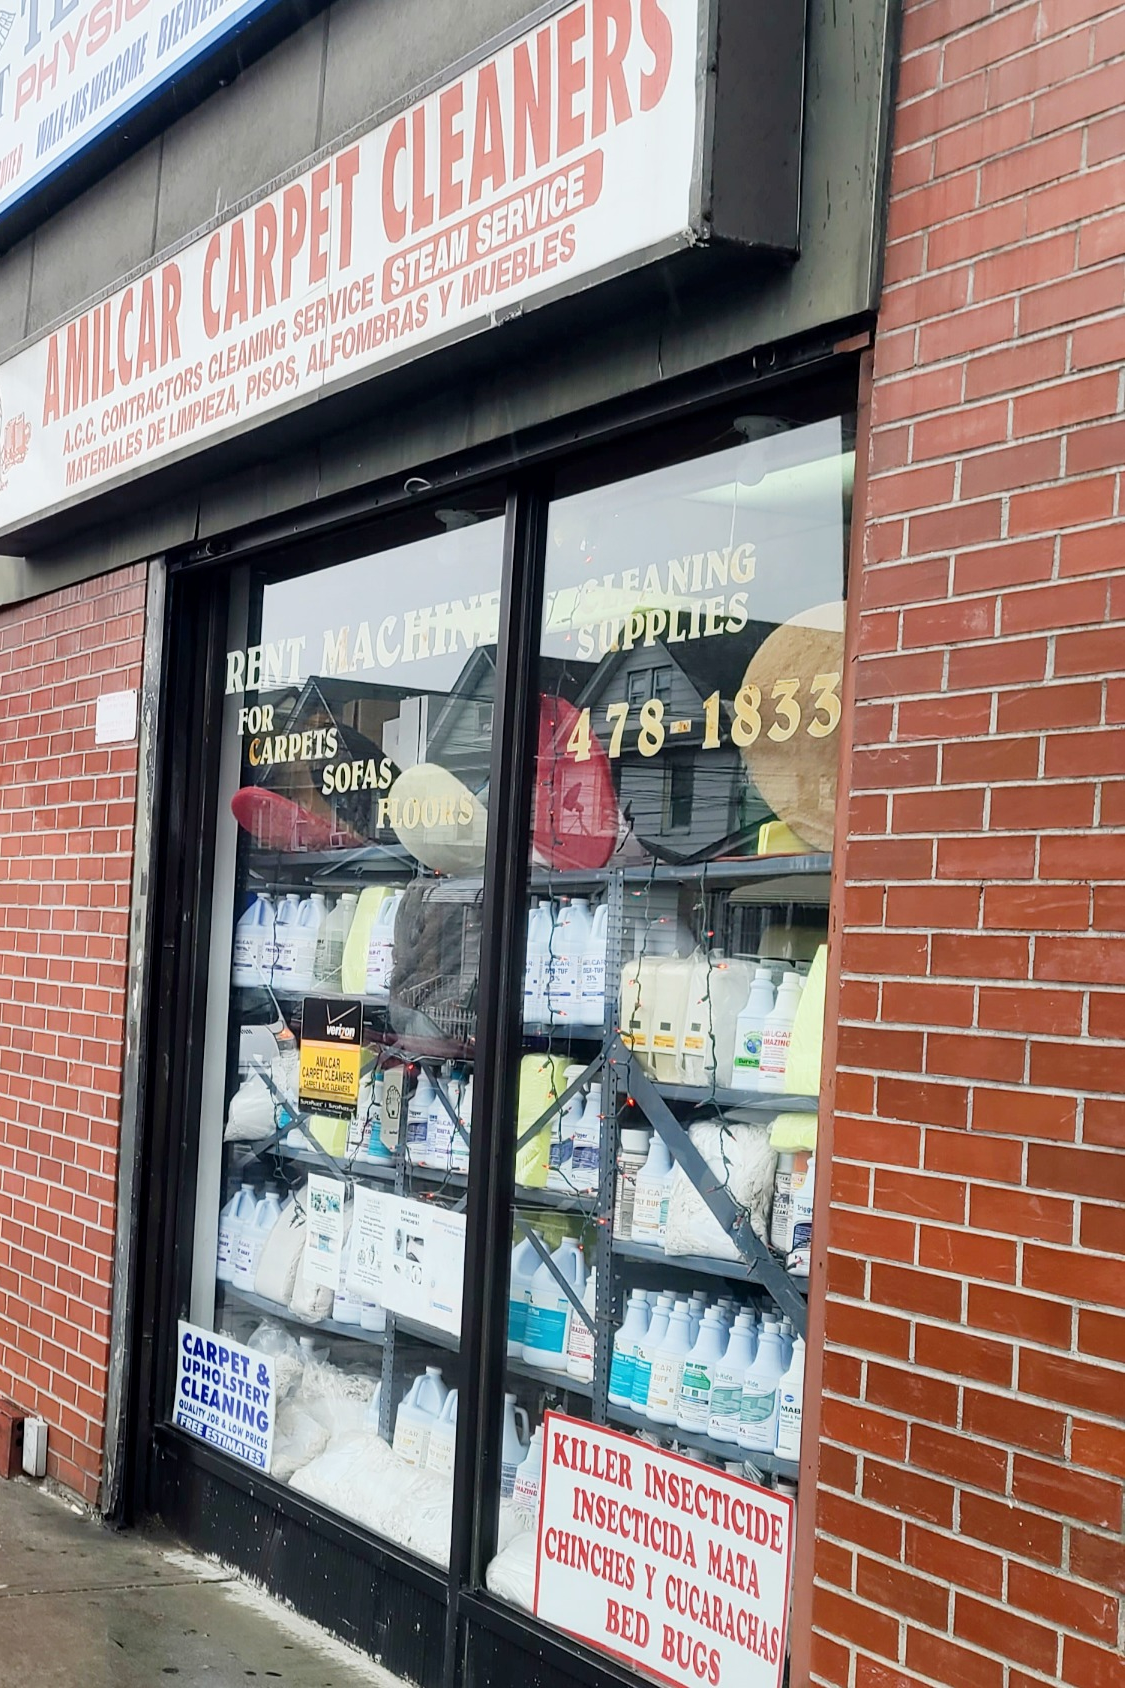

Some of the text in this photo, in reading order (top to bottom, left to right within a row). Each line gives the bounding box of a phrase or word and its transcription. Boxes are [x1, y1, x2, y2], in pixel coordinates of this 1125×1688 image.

[36, 82, 89, 160] WALK-INS
[89, 31, 148, 116] WELCOME
[156, 0, 225, 59] BIENVE
[42, 0, 673, 427] AMILCAR CARPET CLEANERS
[390, 163, 587, 297] STEAM SERVICE
[63, 273, 375, 456] A.C.C. CONTRACTORS CLEANING SERVICE
[66, 224, 577, 486] MATERIALES DE LIMPIEZA, PISOS, ALFOMBRAS Y MUEBLES
[579, 543, 756, 614] CLEANING
[575, 591, 749, 660] SUPPLIES
[225, 635, 306, 695] RENT
[237, 704, 274, 736] FOR
[249, 727, 338, 767] CARPETS
[565, 672, 842, 762] 478-1833
[322, 757, 393, 795] SOFAS
[376, 790, 475, 830] FLOORS
[327, 1023, 356, 1040] verizon
[302, 1067, 354, 1084] CARPET CLEANERS
[315, 1056, 341, 1069] AMILCAR
[182, 1333, 270, 1389] CARPET &
[183, 1356, 270, 1408] UPHOLSTERY
[179, 1399, 268, 1450] QUALITY JOB & LOW PRICES
[181, 1376, 269, 1433] CLEANING
[180, 1416, 263, 1466] FREE ESTIMATES
[553, 1432, 783, 1554] KILLER INSECTICIDE
[572, 1487, 761, 1600] INSECTICIDA MATA
[545, 1527, 780, 1666] CHINCHES Y CUCARACHAS
[605, 1598, 721, 1687] BED BUGS
